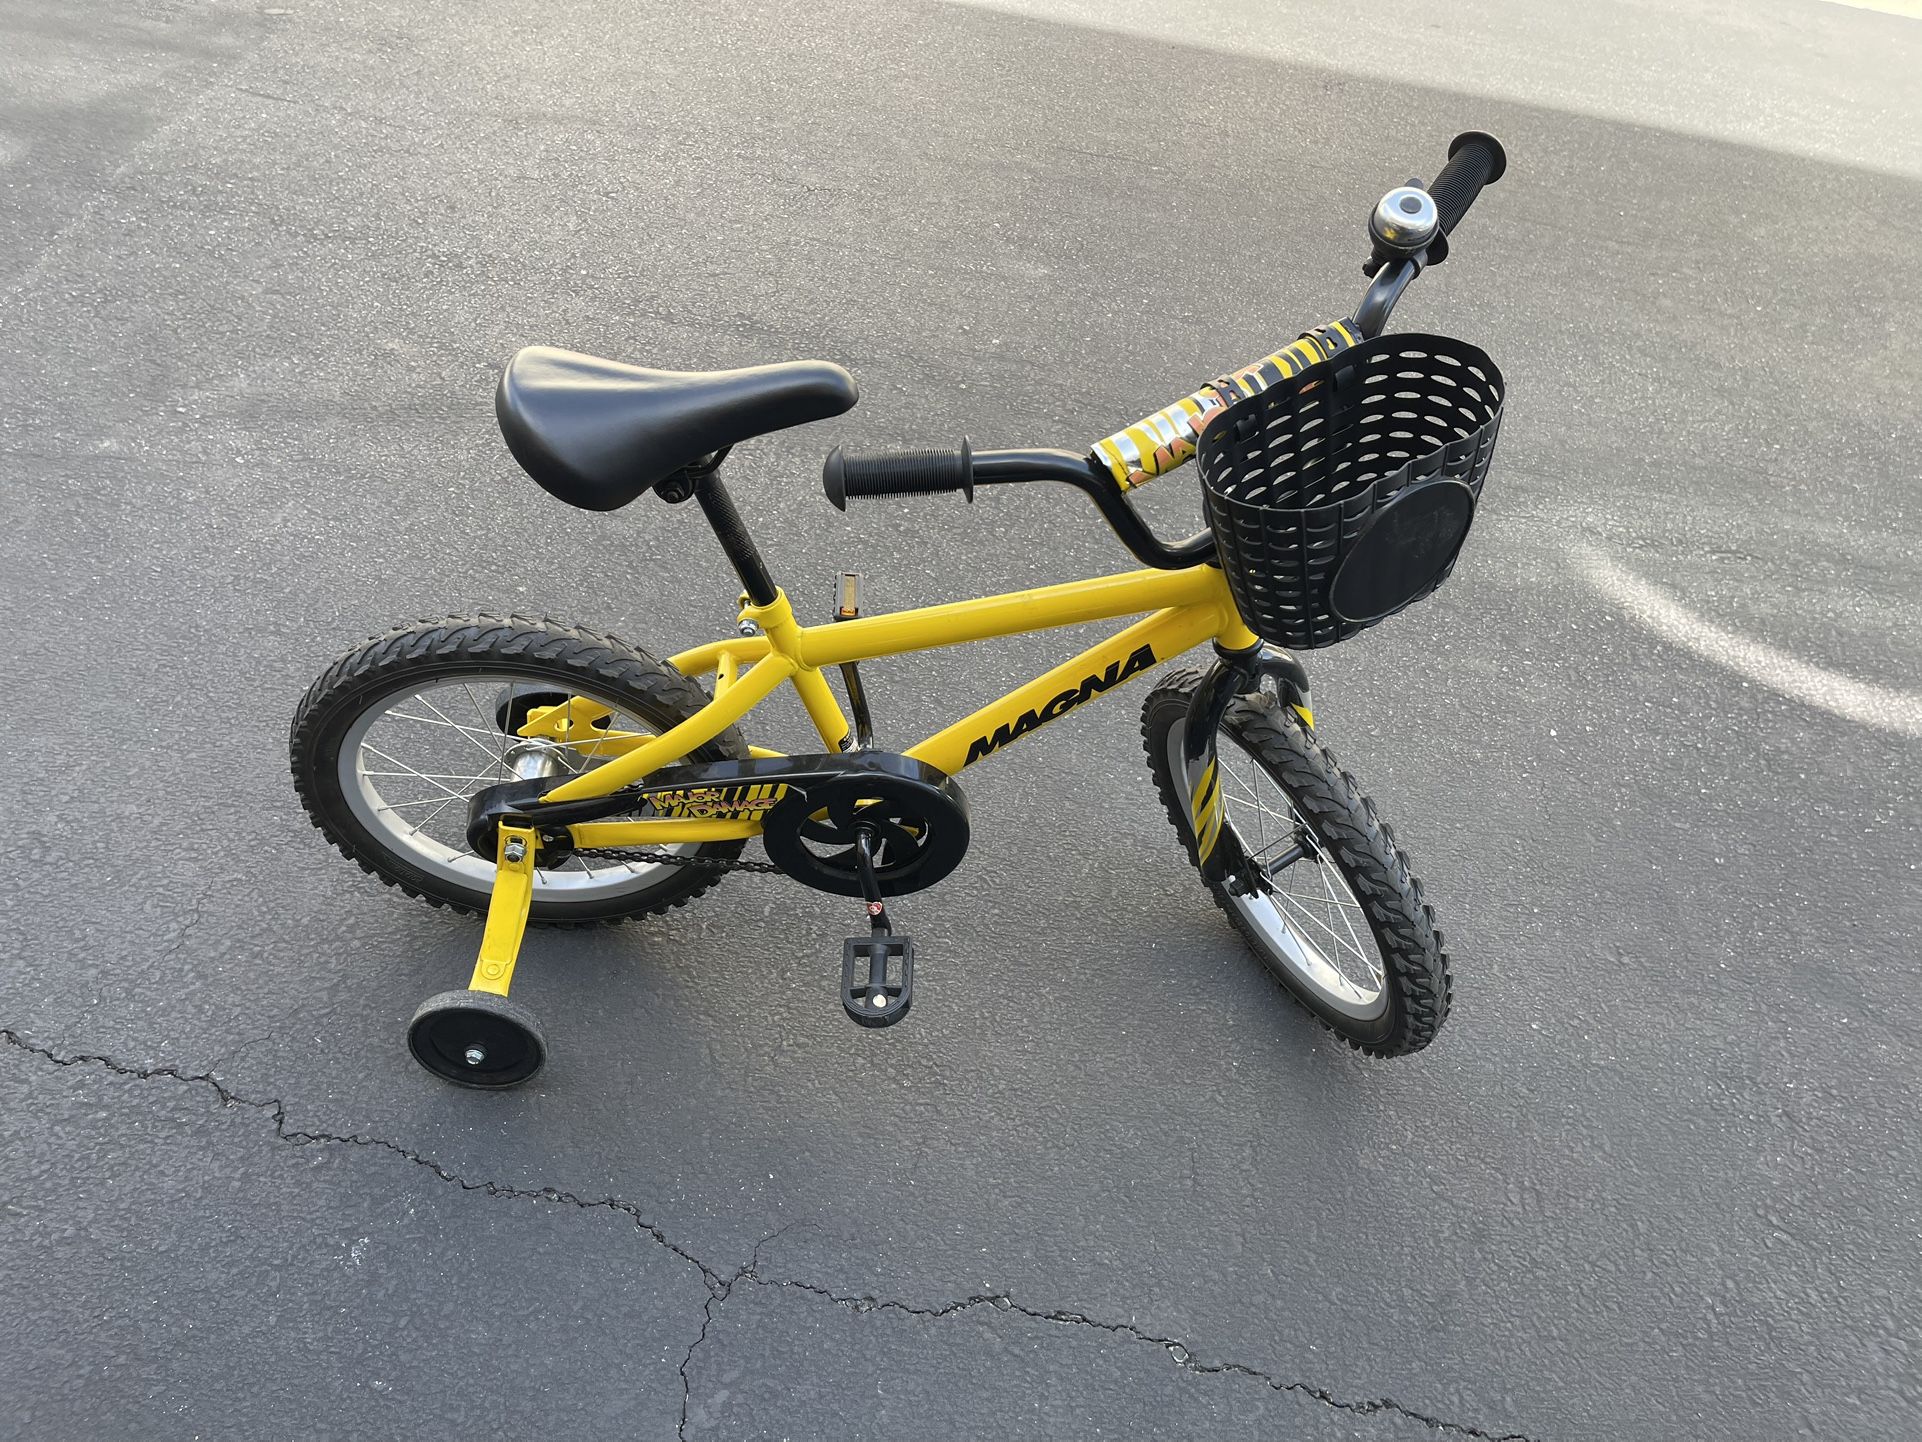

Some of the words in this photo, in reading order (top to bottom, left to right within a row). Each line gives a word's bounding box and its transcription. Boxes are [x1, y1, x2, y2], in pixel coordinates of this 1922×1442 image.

[963, 643, 1157, 767] MAGNA
[648, 791, 721, 810] MAJOR
[688, 798, 777, 818] DAMAGE
